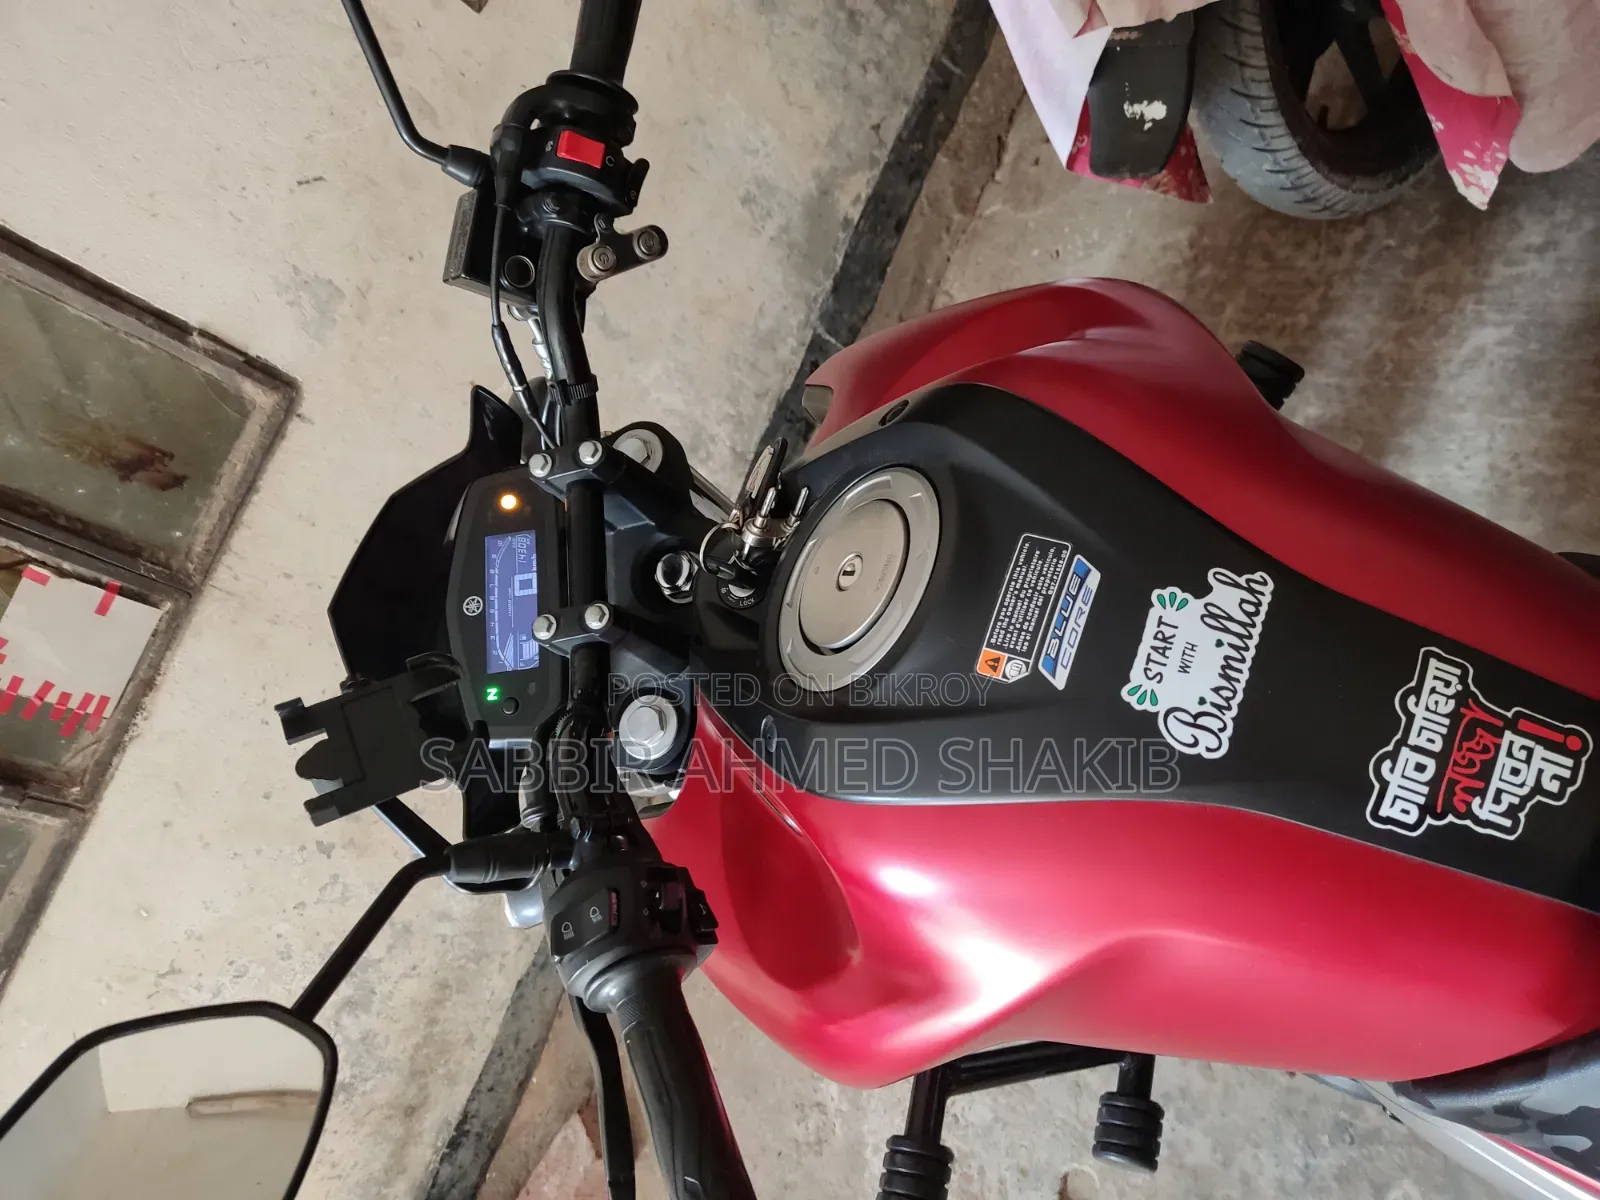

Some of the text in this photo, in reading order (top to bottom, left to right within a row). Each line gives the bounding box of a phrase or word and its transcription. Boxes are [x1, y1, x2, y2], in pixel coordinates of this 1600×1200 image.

[518, 537, 527, 563] 14308
[514, 572, 537, 596] 0
[740, 597, 756, 606] LOCK
[1003, 581, 1015, 605] operate
[1026, 591, 1039, 620] conducir
[995, 630, 1005, 645] read
[1004, 590, 1018, 615] owner's
[1028, 607, 1040, 631] manual
[1047, 573, 1081, 659] BLUE
[1060, 584, 1093, 669] CORE
[1143, 615, 1179, 684] START
[1163, 571, 1268, 753] Bismillah
[1177, 641, 1198, 674] WITH
[487, 687, 498, 701] N
[1436, 698, 1504, 813] লজ্জা
[1378, 746, 1436, 825] চাবি
[1471, 730, 1536, 828] দিবেন
